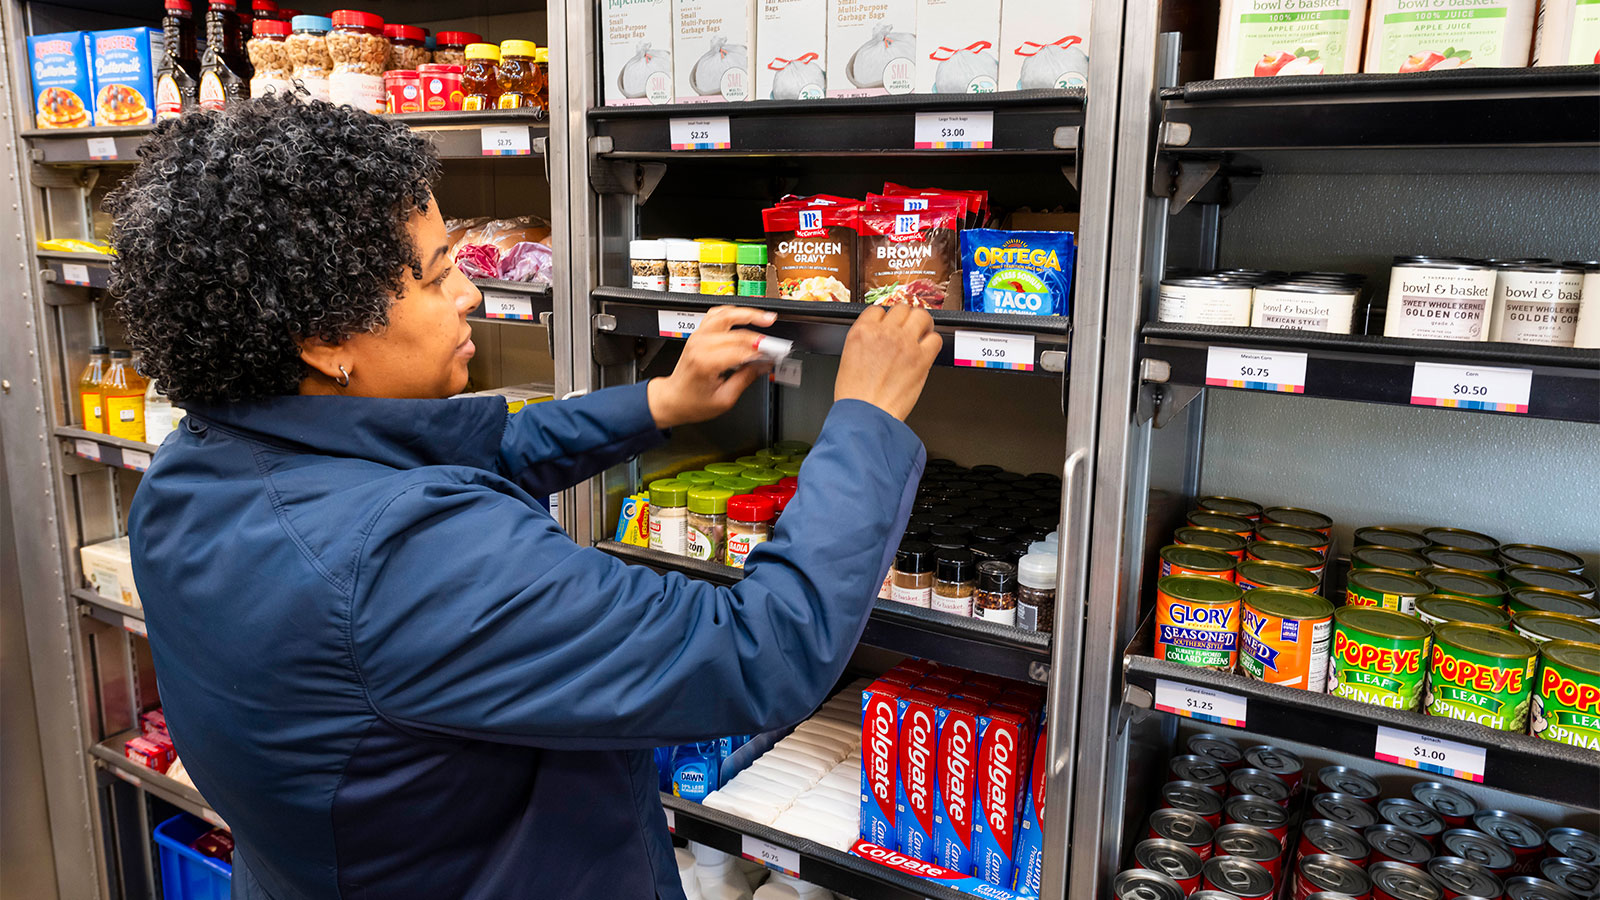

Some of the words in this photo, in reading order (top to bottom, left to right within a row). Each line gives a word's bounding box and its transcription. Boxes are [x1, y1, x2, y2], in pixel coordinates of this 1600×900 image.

[765, 5, 779, 13] Bags
[838, 4, 888, 14] Multi-Purpose
[1253, 0, 1280, 10] bowl
[1299, 0, 1339, 8] basket
[838, 14, 867, 22] Garbage
[869, 11, 886, 20] Bags
[1296, 12, 1320, 20] JUICE
[681, 18, 722, 27] Multi-Purpose
[1268, 24, 1293, 32] APPLE
[1296, 23, 1319, 31] JUICE
[681, 26, 704, 35] Garbage
[706, 25, 720, 33] Bags
[970, 84, 979, 94] 3
[801, 91, 809, 100] 3
[690, 131, 709, 140] $2.25
[941, 128, 965, 138] $3.00
[778, 241, 842, 255] CHICKEN
[876, 246, 932, 259] BROWN
[794, 255, 827, 264] GRAVY
[888, 259, 923, 269] GRAVY
[974, 245, 1062, 272] ORTEGA
[1402, 282, 1430, 294] bowl
[1434, 284, 1447, 295] &
[1450, 284, 1489, 297] basket
[1505, 286, 1538, 299] bowl
[1541, 288, 1554, 300] &
[993, 290, 1042, 311] TACO
[1402, 299, 1427, 309] SWEET
[1428, 301, 1457, 310] WHOLE
[1459, 303, 1485, 311] KERNEL
[1263, 303, 1282, 313] bowl
[1296, 305, 1330, 316] basket
[1405, 308, 1450, 319] GOLDEN
[1454, 311, 1481, 320] CORN
[1506, 304, 1534, 312] SWEET
[1535, 306, 1565, 314] WHOLE
[1266, 316, 1296, 325] MEXICAN
[1298, 318, 1321, 327] STYLE
[1510, 312, 1558, 323] GOLDEN
[1561, 315, 1578, 324] COR
[678, 321, 696, 331] $2.00
[981, 347, 1006, 358] $0.50
[1240, 366, 1270, 378] $0.75
[1452, 383, 1488, 396] $0.50
[688, 542, 704, 554] zón
[730, 541, 748, 553] BADIA
[1169, 602, 1234, 630] GLORY
[1242, 606, 1268, 638] ORY
[1164, 626, 1235, 646] SEASONED
[1173, 637, 1207, 649] SOUTHERN
[1241, 630, 1271, 659] ONED
[1334, 629, 1421, 674] POPEYE
[1166, 650, 1202, 665] COLLARD
[1202, 656, 1229, 666] GREENS
[1431, 643, 1524, 694] POPEYE
[1356, 677, 1390, 688] LEAF
[1541, 666, 1600, 713] POP
[1338, 682, 1405, 710] SPINACH
[1452, 688, 1489, 706] LEAF
[1186, 697, 1214, 711] $1.25
[1433, 699, 1505, 730] SPINACH
[1572, 713, 1600, 730] LEA
[1420, 734, 1442, 744] Spinach
[1548, 725, 1600, 752] SPINA
[872, 701, 894, 800] Colgate
[1413, 745, 1447, 762] $1.00
[908, 710, 932, 811] Colgate
[947, 719, 972, 821] Colgate
[681, 772, 705, 782] DAWN
[988, 727, 1014, 831] Colgate
[762, 850, 780, 862] $0.75
[857, 842, 943, 878] Colgate
